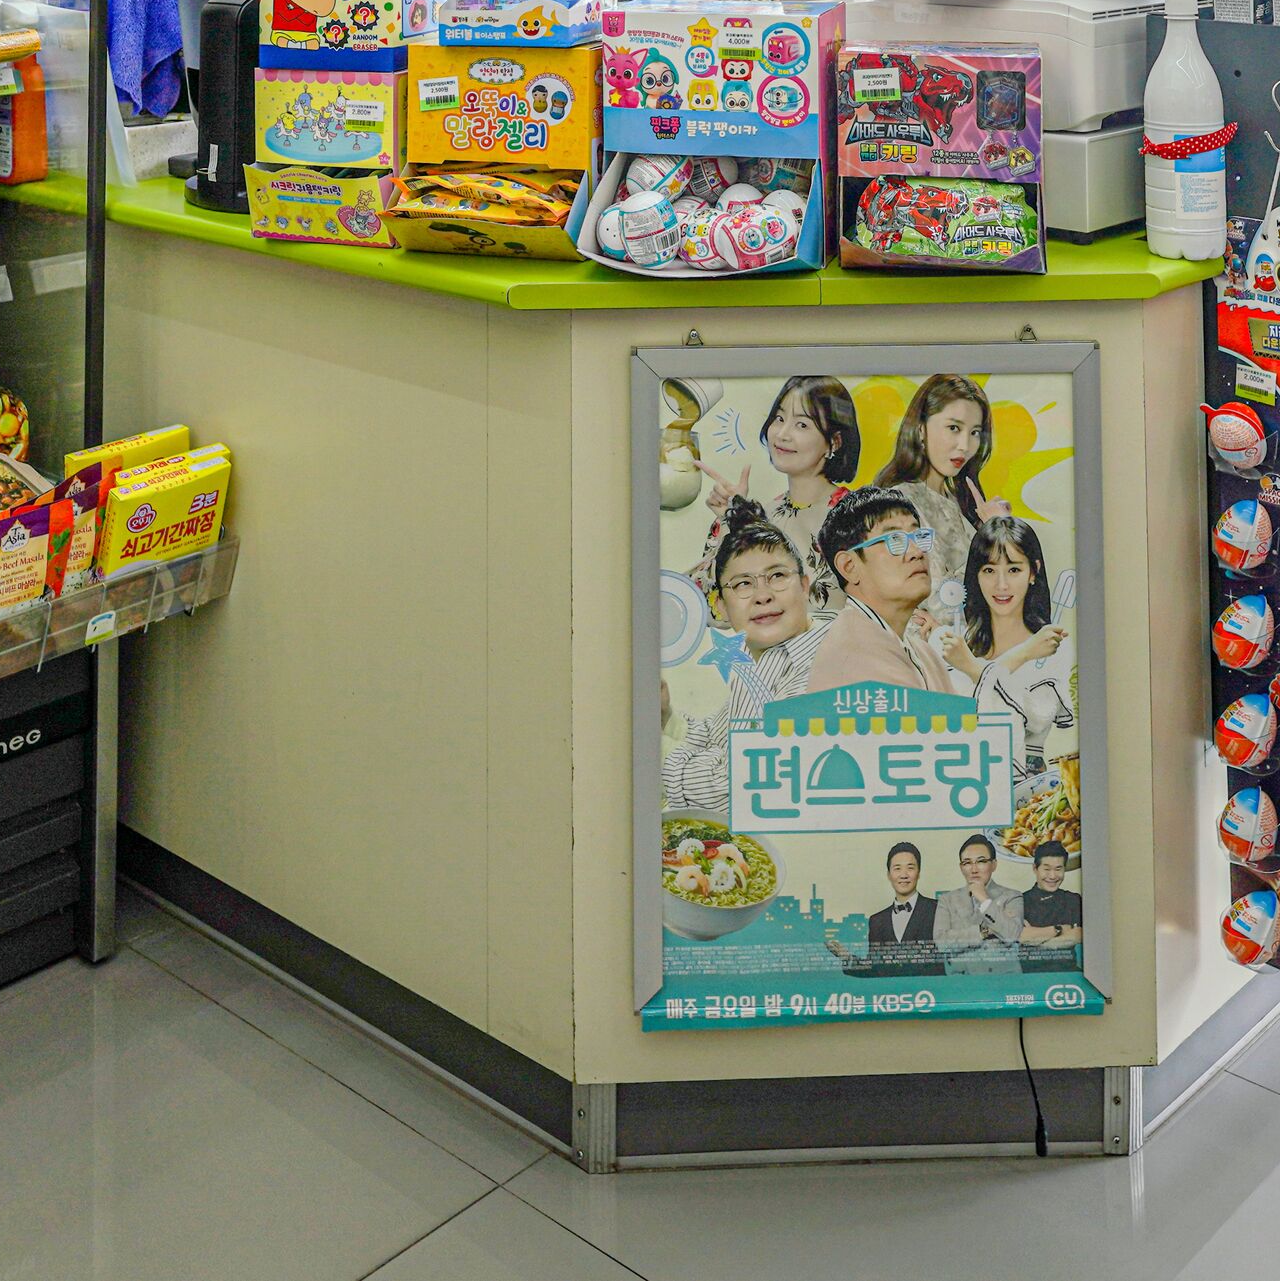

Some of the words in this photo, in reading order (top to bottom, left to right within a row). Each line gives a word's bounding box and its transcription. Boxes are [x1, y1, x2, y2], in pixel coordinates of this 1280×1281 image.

[727, 36, 751, 45] 4,000원
[865, 78, 888, 88] 2,500원
[443, 118, 551, 152] 말랑젤리
[880, 143, 918, 164] 키링
[1243, 373, 1266, 384] 2,000원
[188, 490, 219, 515] 3분
[120, 511, 216, 561] 쇠고기간짜장
[1, 558, 18, 571] Beef
[19, 553, 45, 567] Masala
[832, 688, 910, 714] 신상출시
[742, 739, 1003, 819] 편스토랑
[665, 997, 698, 1019] 매주
[704, 994, 756, 1018] 금요일
[763, 993, 785, 1018] 밤
[789, 992, 818, 1017] 9시
[823, 991, 866, 1015] 40분
[1051, 991, 1080, 1006] CU
